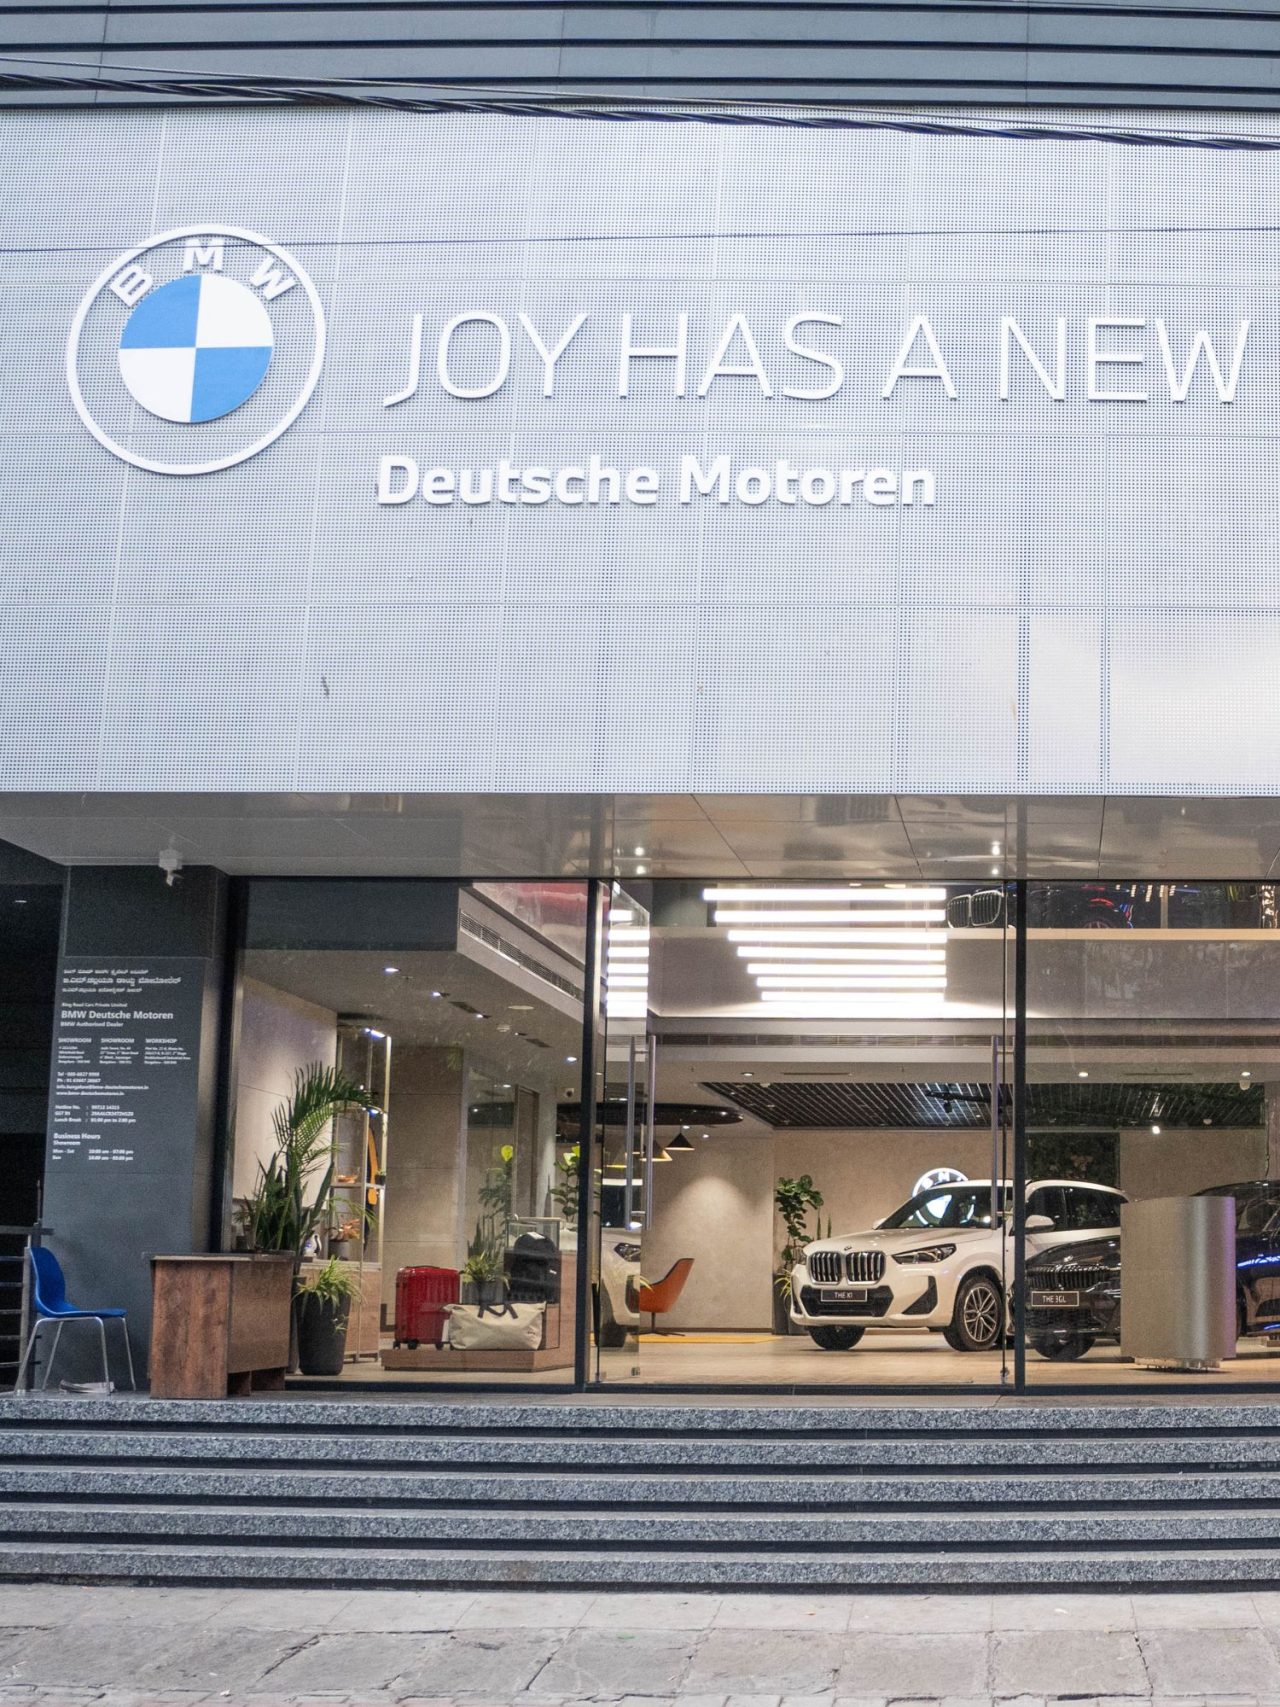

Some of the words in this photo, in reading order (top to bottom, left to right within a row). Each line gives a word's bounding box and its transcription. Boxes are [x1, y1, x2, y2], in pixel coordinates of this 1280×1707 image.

[109, 237, 299, 308] BMW
[383, 312, 589, 408] JOY
[618, 311, 844, 401] HAS
[881, 314, 959, 401] A
[998, 315, 1251, 404] NEW
[376, 455, 660, 506] Deutsche
[678, 455, 937, 508] Motoren
[61, 1010, 87, 1019] BMW
[88, 1010, 132, 1019] Deutsche
[133, 1011, 174, 1020] Motoren
[833, 1291, 846, 1299] THE
[1042, 1295, 1054, 1303] THE
